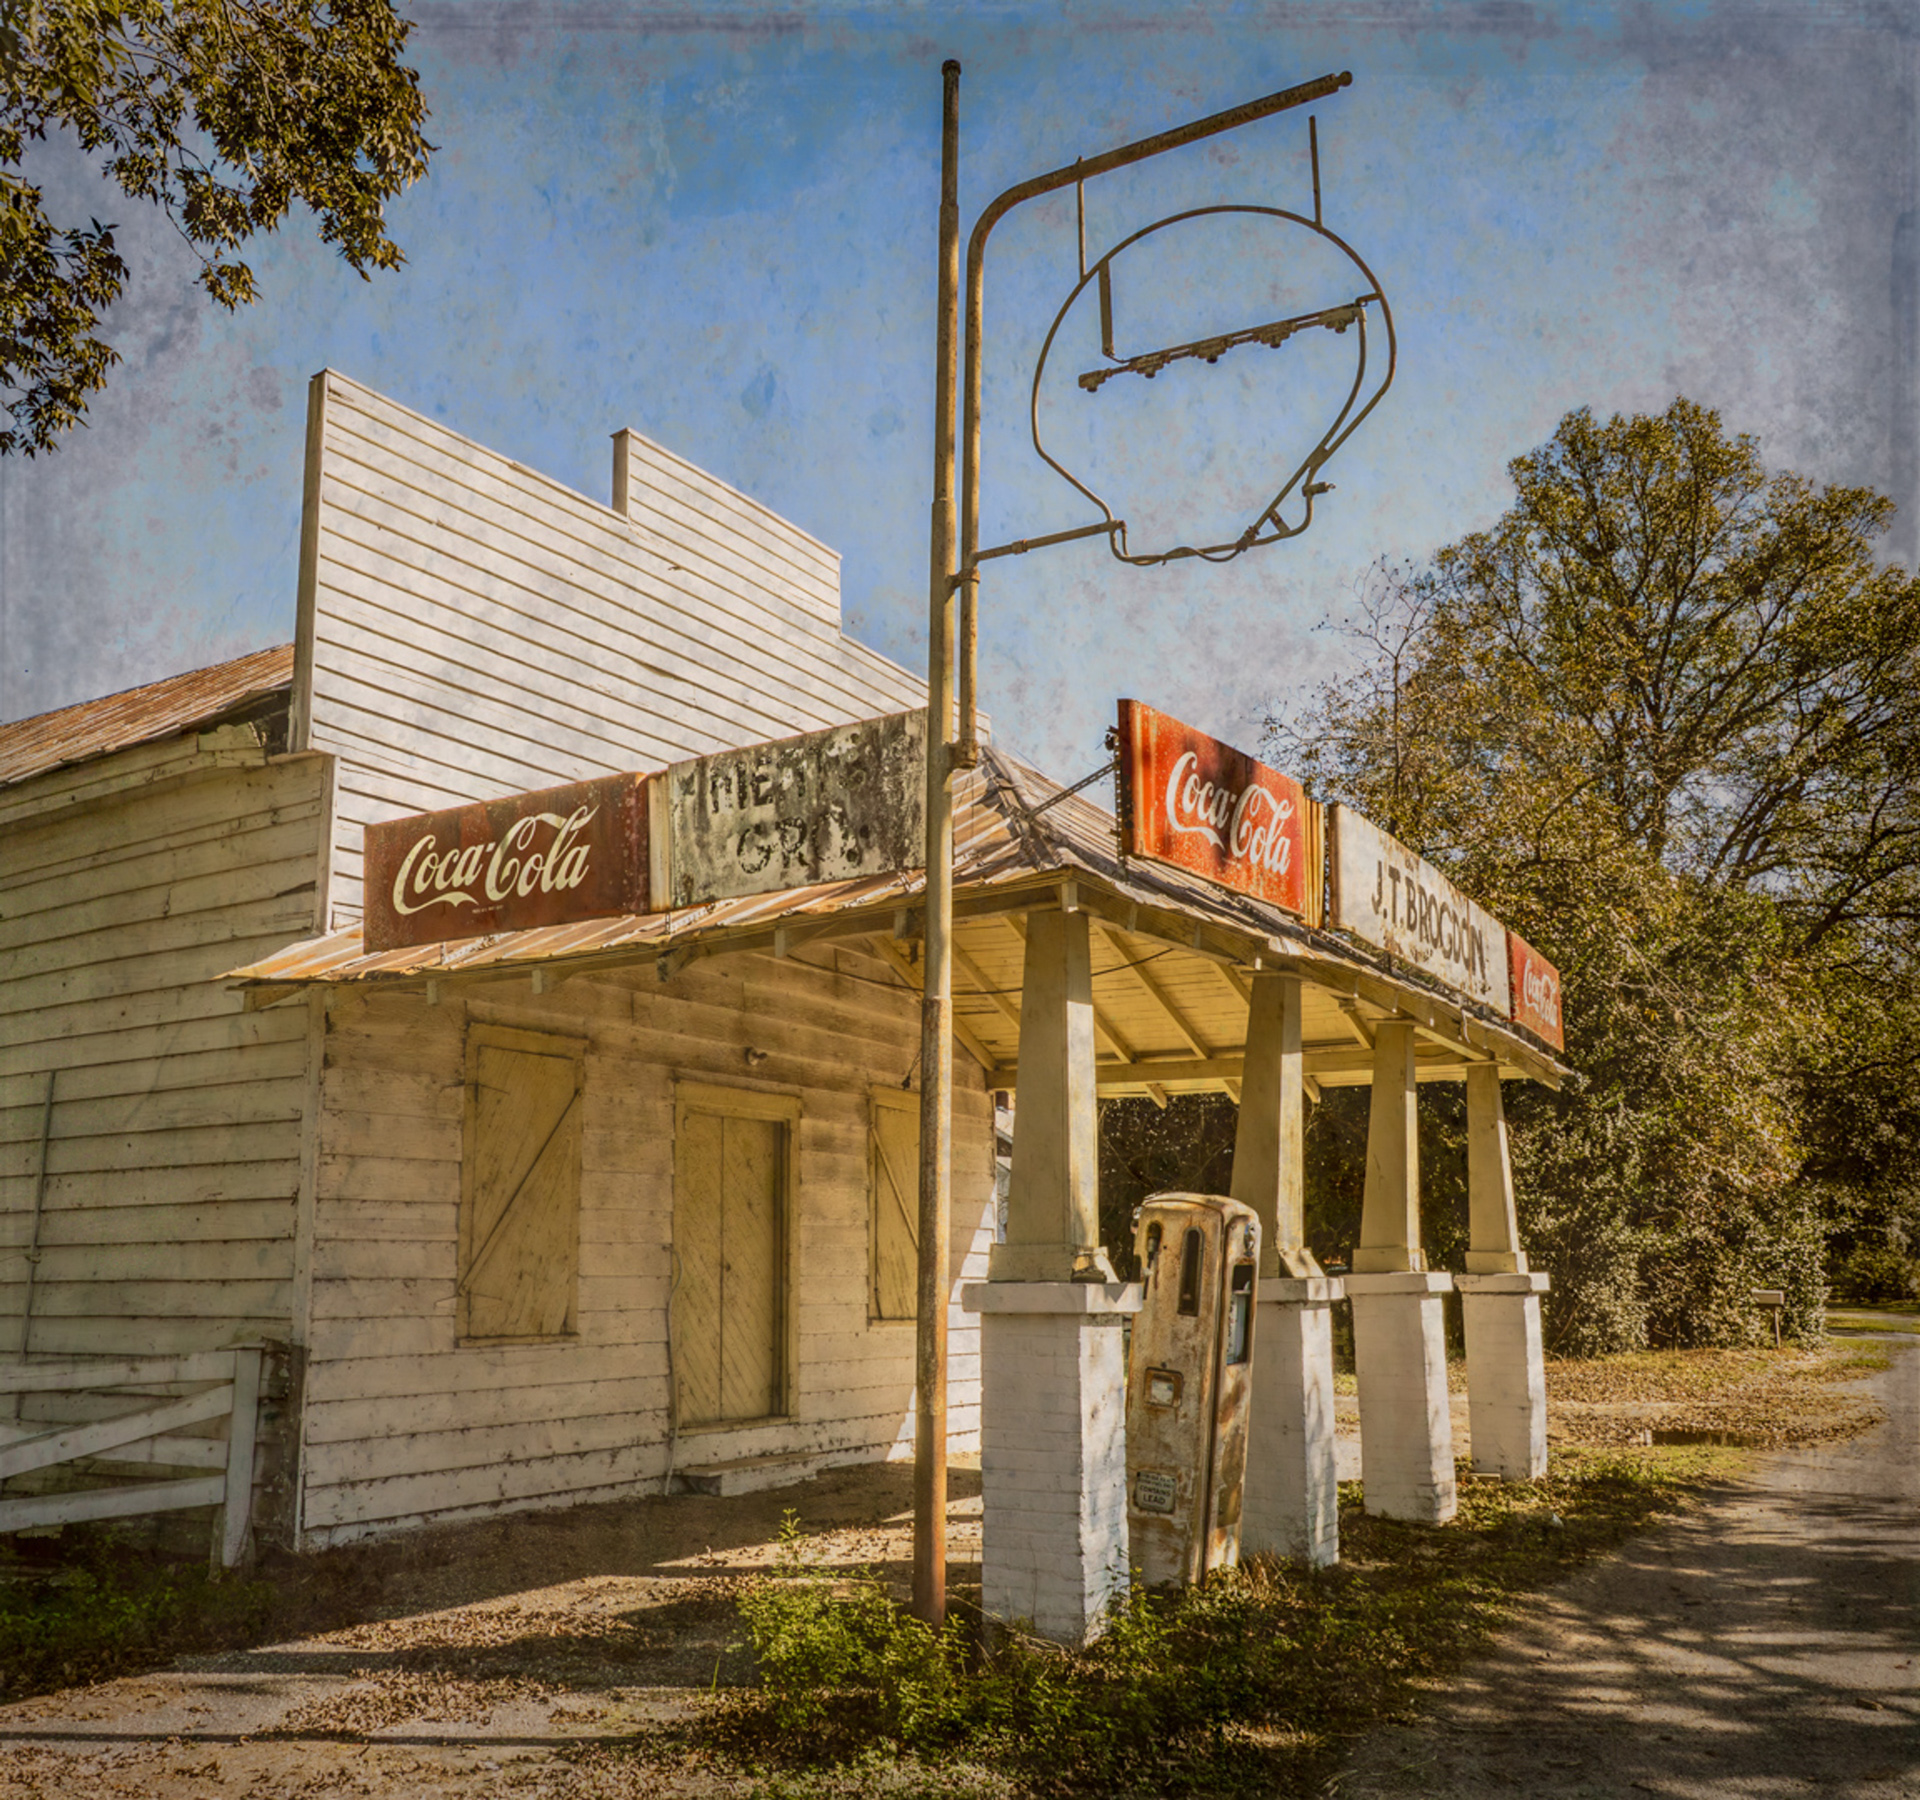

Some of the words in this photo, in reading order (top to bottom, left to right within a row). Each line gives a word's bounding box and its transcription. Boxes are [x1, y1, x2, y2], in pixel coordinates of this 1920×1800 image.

[1166, 751, 1294, 876] Coca-Cola
[393, 804, 600, 916] Coca-Cola
[1405, 875, 1487, 982] BROGDON
[1523, 958, 1558, 1028] Coca-Cola
[1139, 1484, 1171, 1497] CONTAINS
[1143, 1493, 1166, 1505] LEAD
